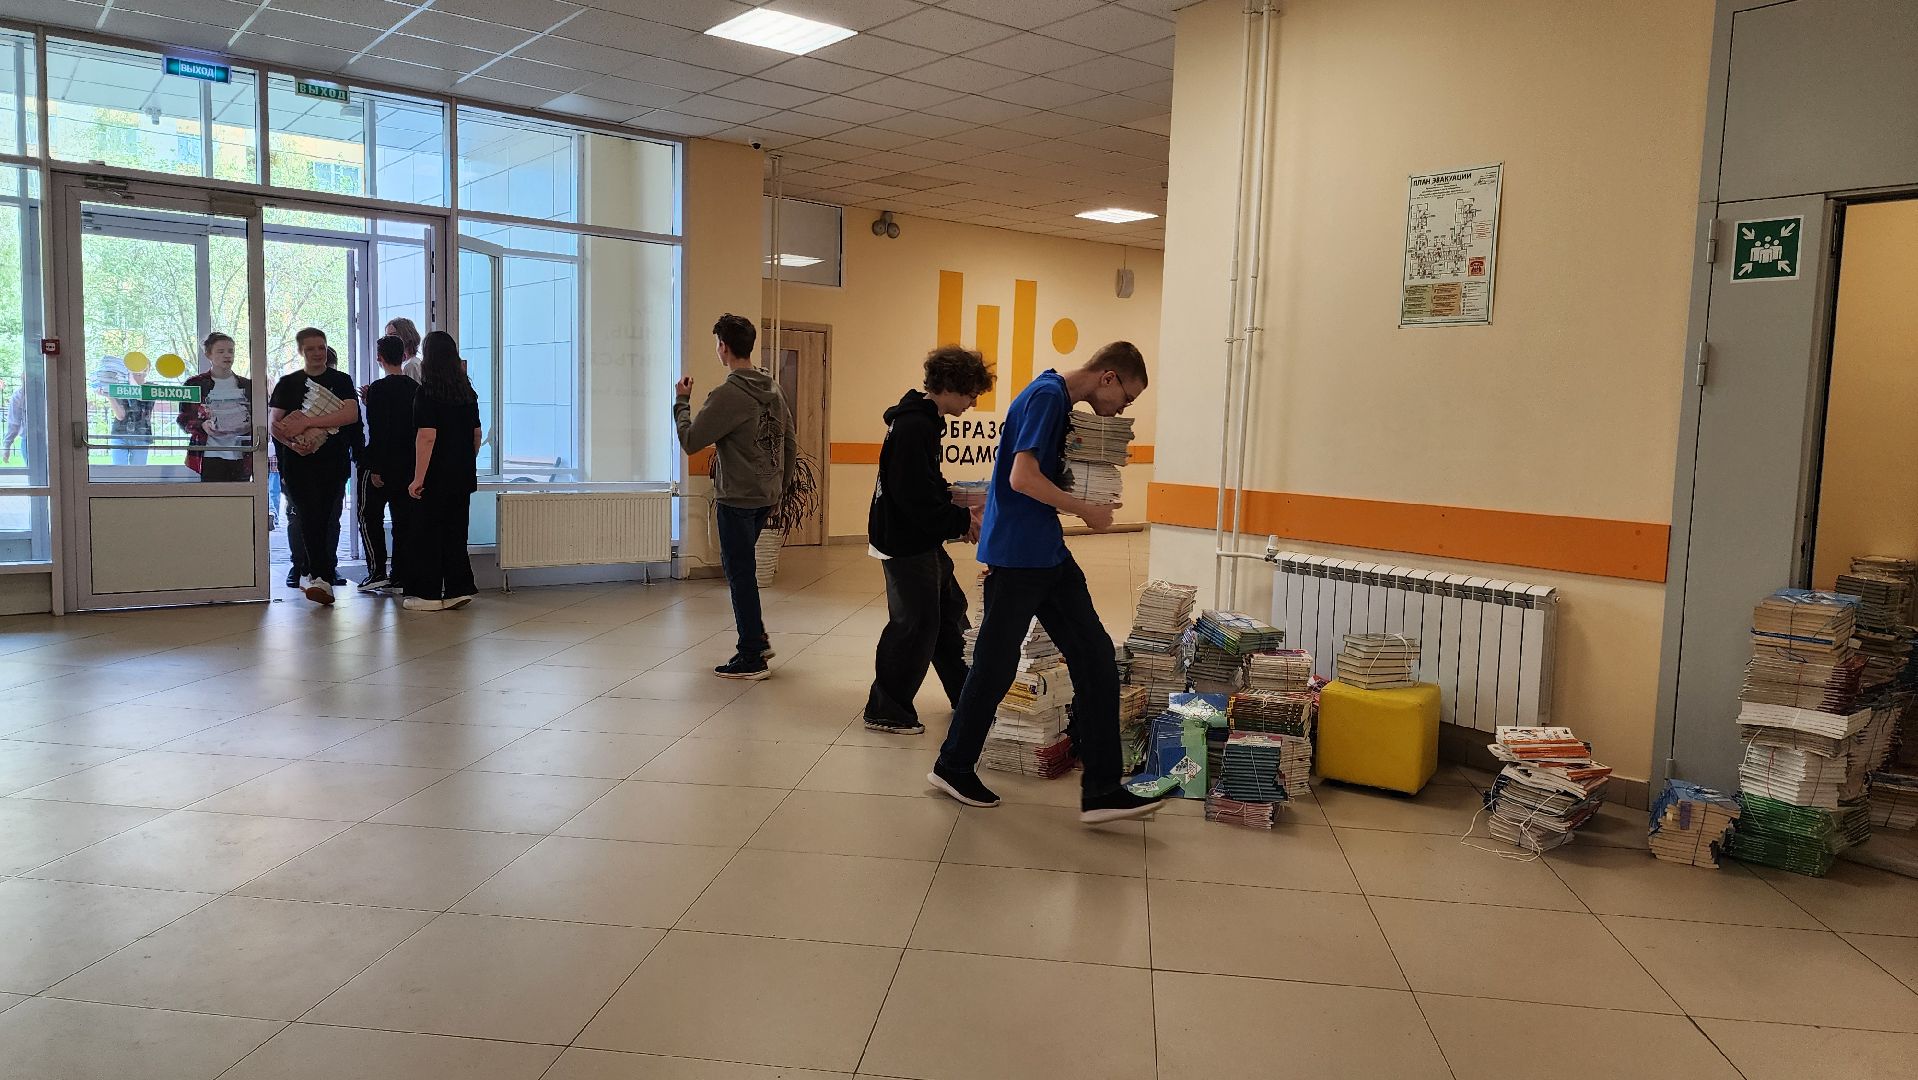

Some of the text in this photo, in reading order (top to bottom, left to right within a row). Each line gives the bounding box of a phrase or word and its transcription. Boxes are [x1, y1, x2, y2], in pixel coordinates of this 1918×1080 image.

[180, 63, 215, 78] ВЫХОД
[300, 83, 347, 101] ВЫХОД
[1413, 178, 1431, 187] ПЛАН
[1432, 172, 1472, 184] ЭВАКУАЦИИ
[116, 386, 141, 396] ВЫХ
[150, 387, 192, 400] ВЫХОД
